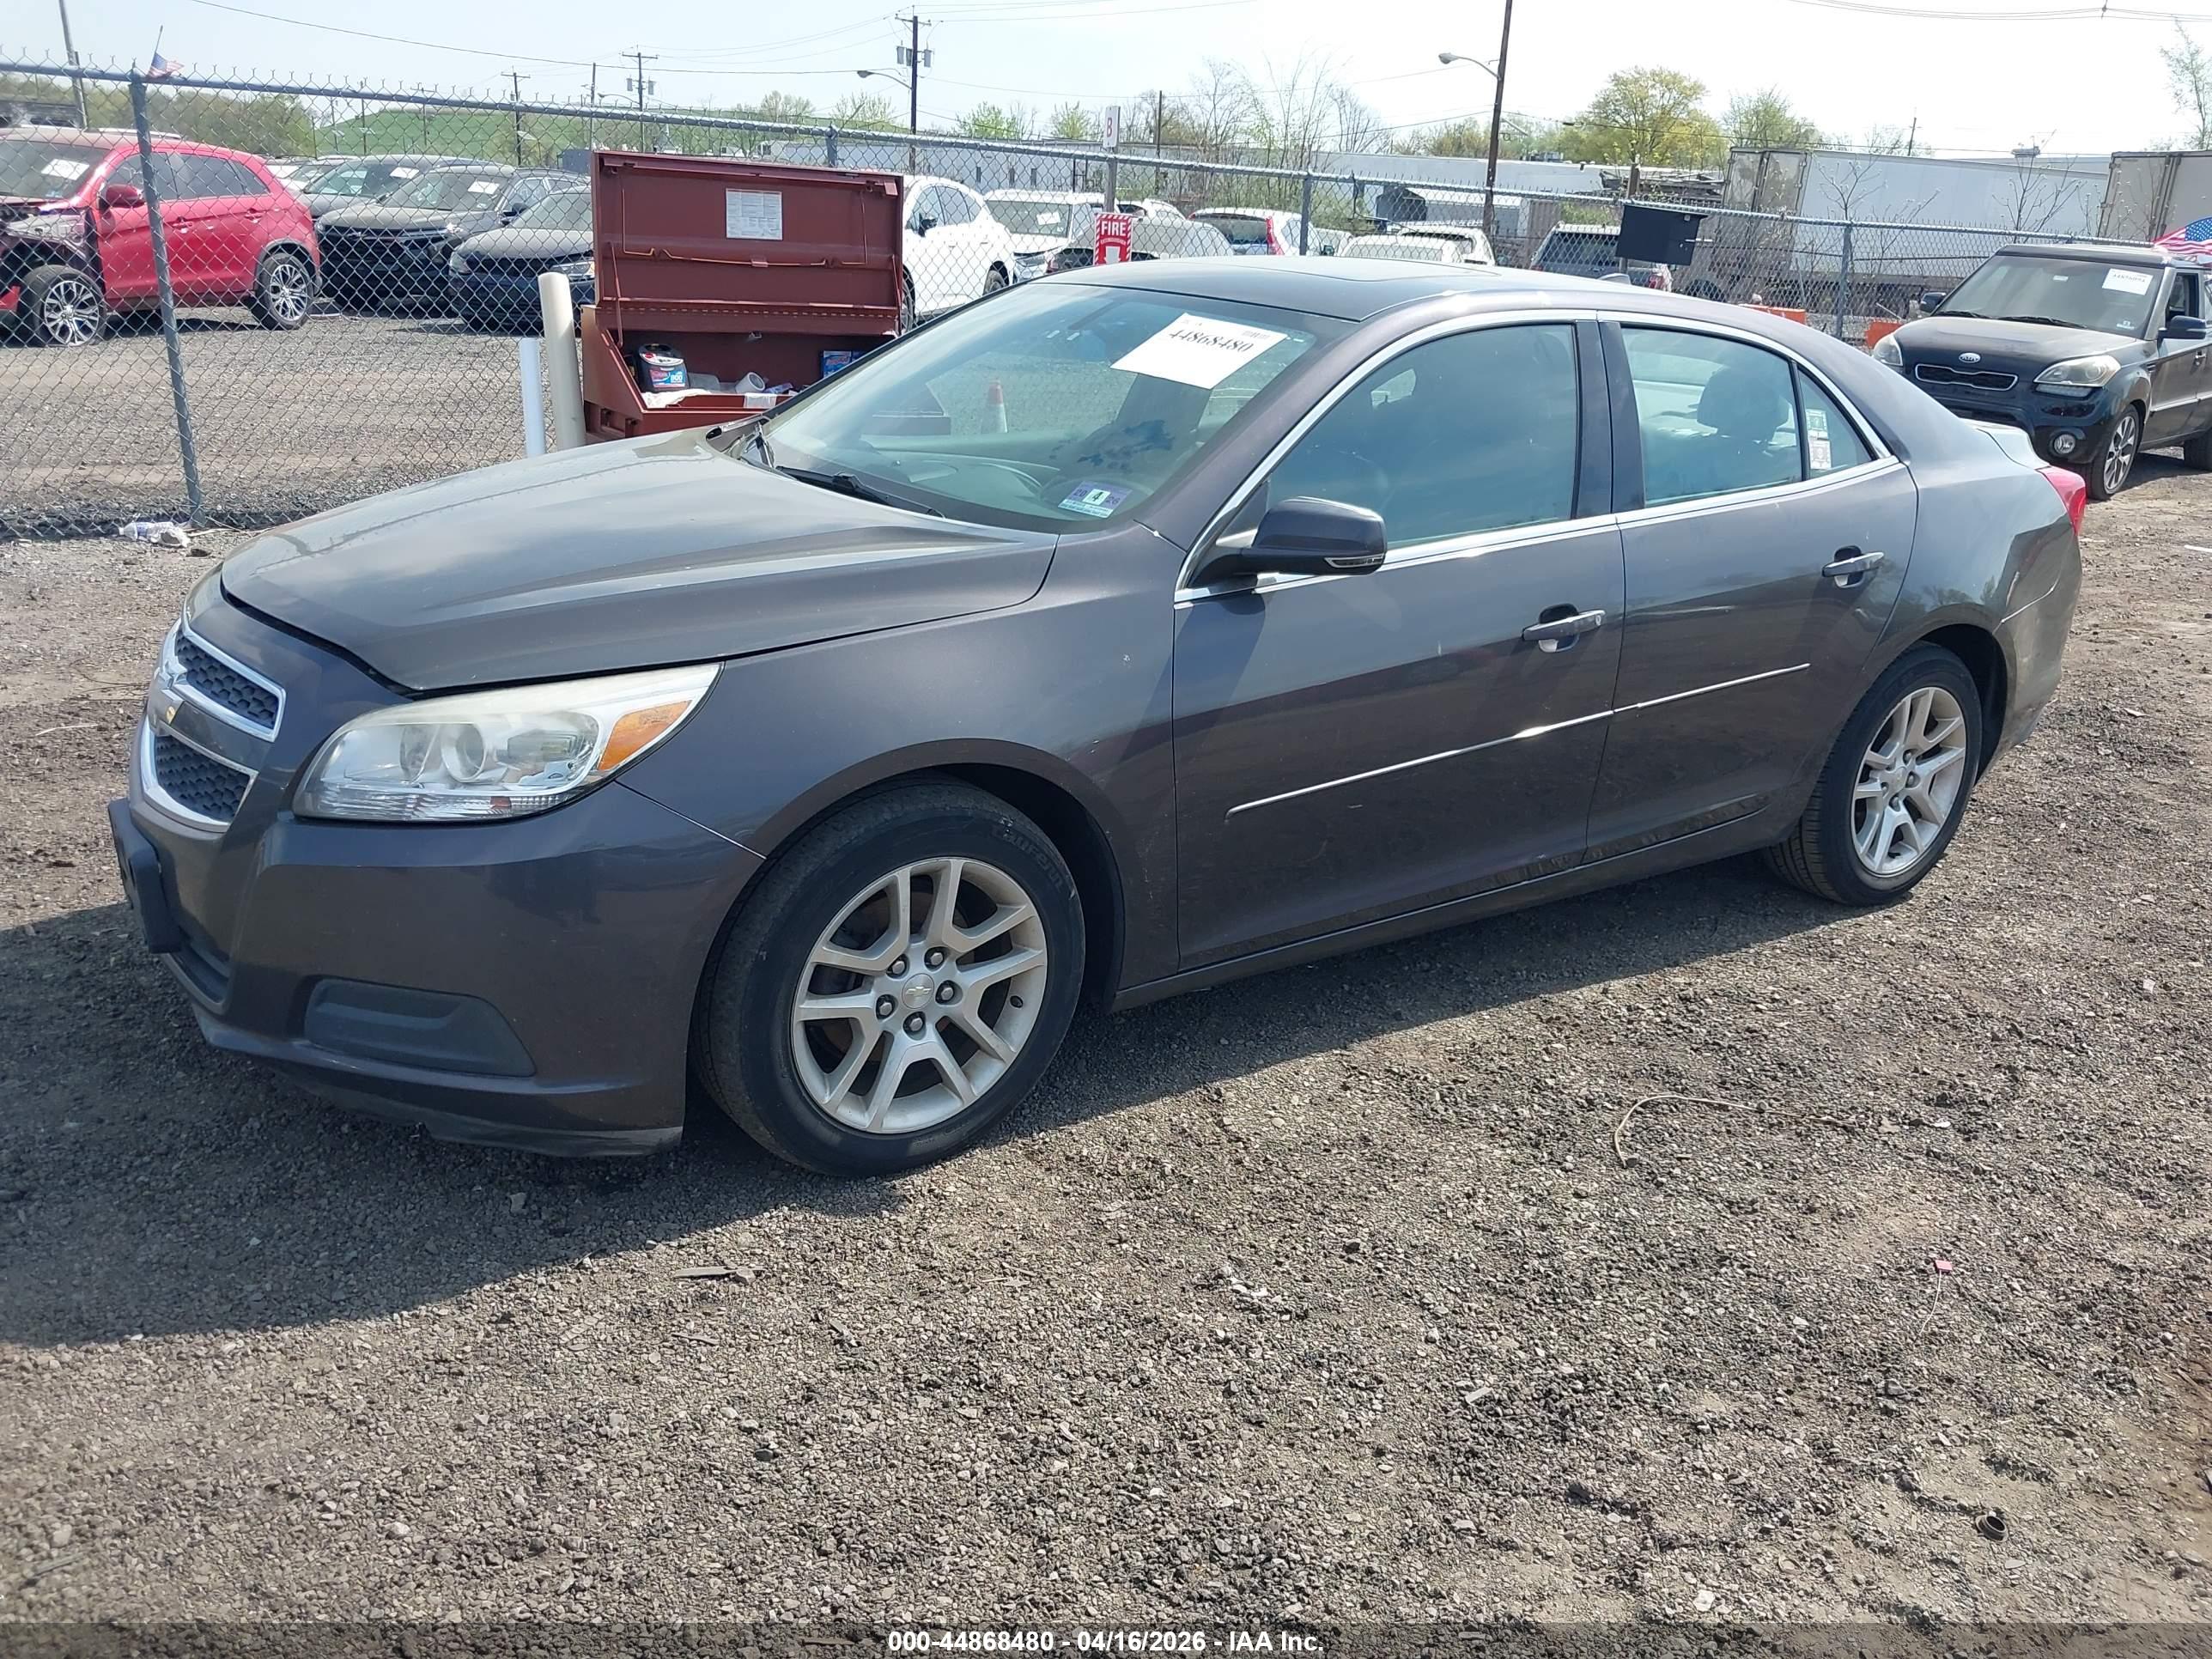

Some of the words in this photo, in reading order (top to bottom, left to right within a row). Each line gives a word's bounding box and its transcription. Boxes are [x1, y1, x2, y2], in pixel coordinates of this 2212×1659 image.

[1106, 117, 1113, 138] B
[1101, 220, 1127, 236] FIRE
[1169, 329, 1254, 353] 44868480
[1091, 491, 1104, 502] 4
